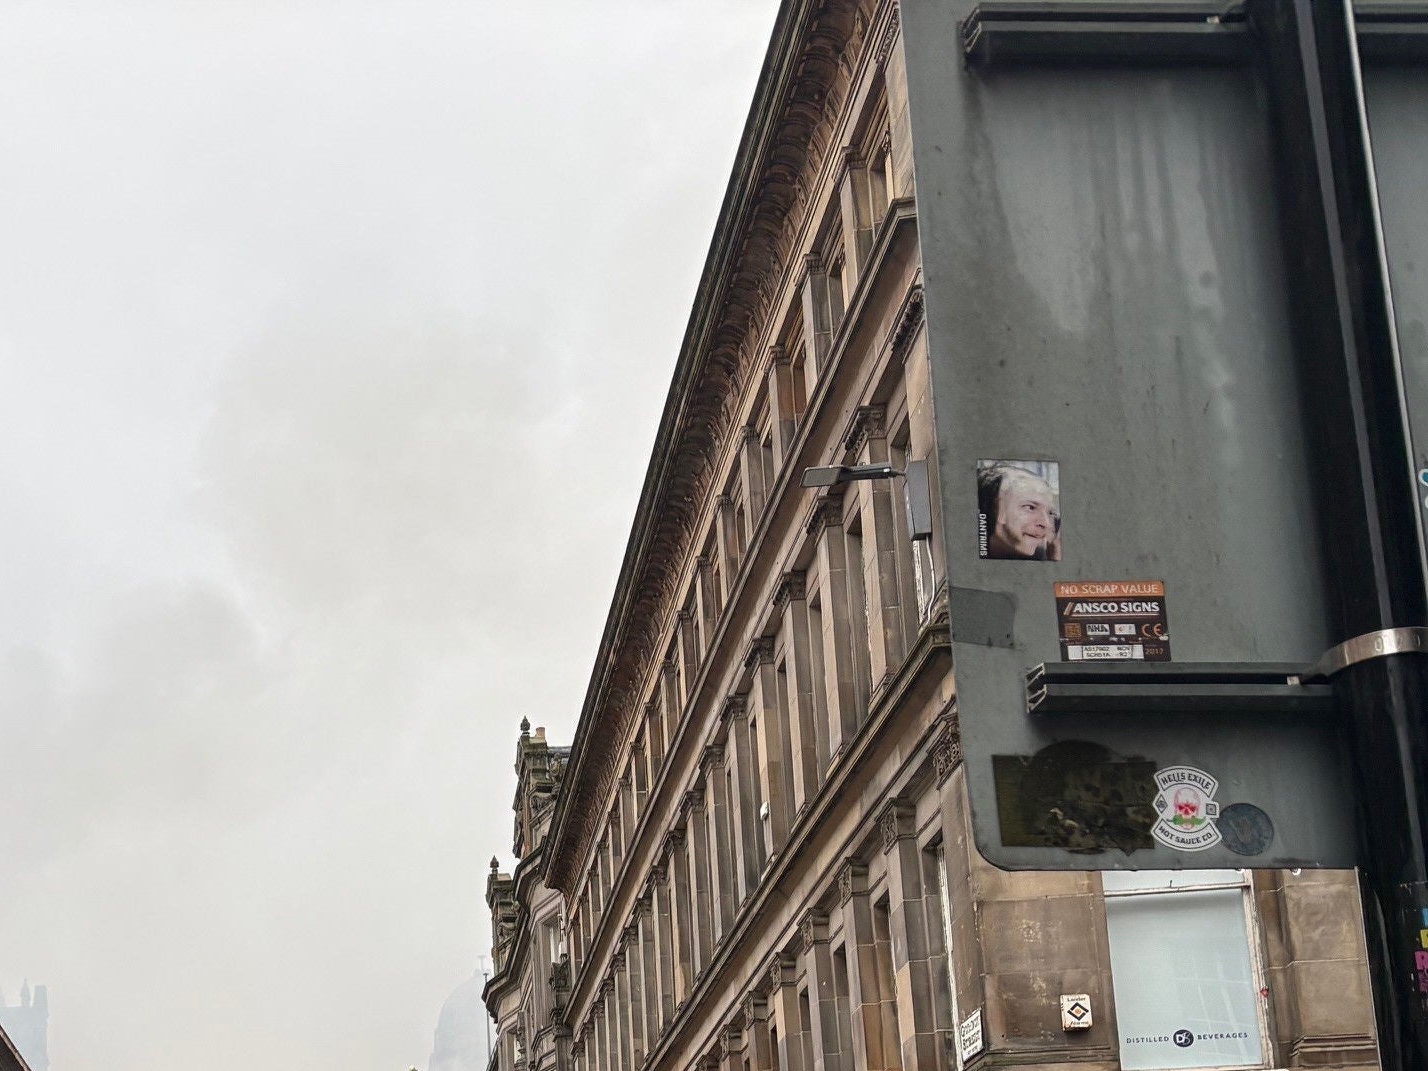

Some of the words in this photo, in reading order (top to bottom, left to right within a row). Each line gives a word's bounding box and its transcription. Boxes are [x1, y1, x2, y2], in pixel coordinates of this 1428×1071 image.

[1060, 585, 1078, 594] NO
[1082, 584, 1118, 594] SCRAP
[1121, 584, 1158, 593] VALUE
[1073, 602, 1119, 613] ANSCO
[1120, 601, 1160, 612] SIGNS
[1160, 772, 1186, 785] HELLS
[1188, 773, 1211, 790] EXILE
[1175, 835, 1202, 845] SAUCE
[1126, 1036, 1170, 1044] DISTILLED
[1197, 1032, 1248, 1040] BEVERAGES
